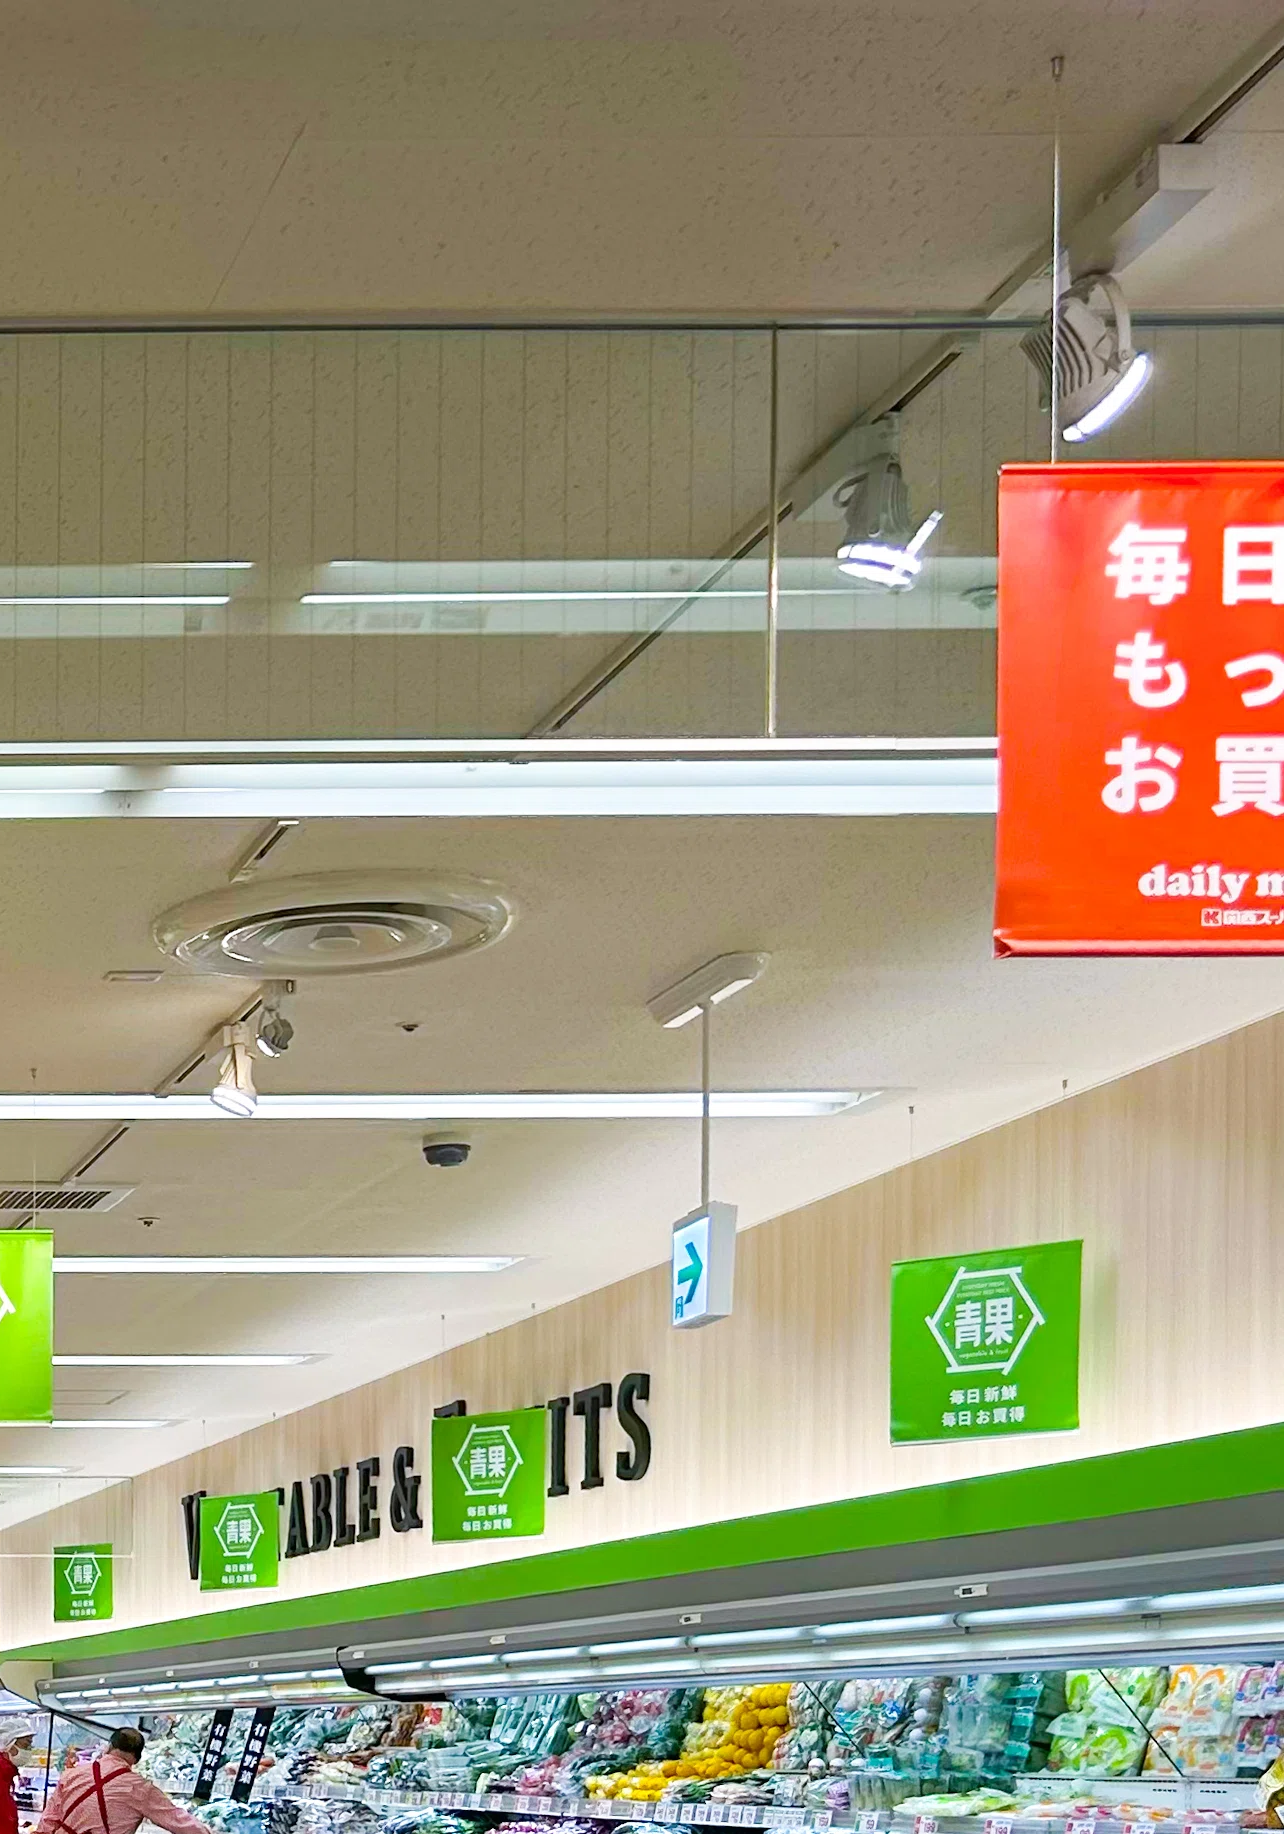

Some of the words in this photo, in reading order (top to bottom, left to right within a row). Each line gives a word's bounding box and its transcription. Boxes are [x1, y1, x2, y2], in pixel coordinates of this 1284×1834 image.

[1105, 522, 1284, 606] 毎日
[1138, 865, 1252, 904] daily
[954, 1296, 1014, 1349] 青果
[470, 1445, 506, 1480] 青果
[226, 1518, 252, 1544] 青果
